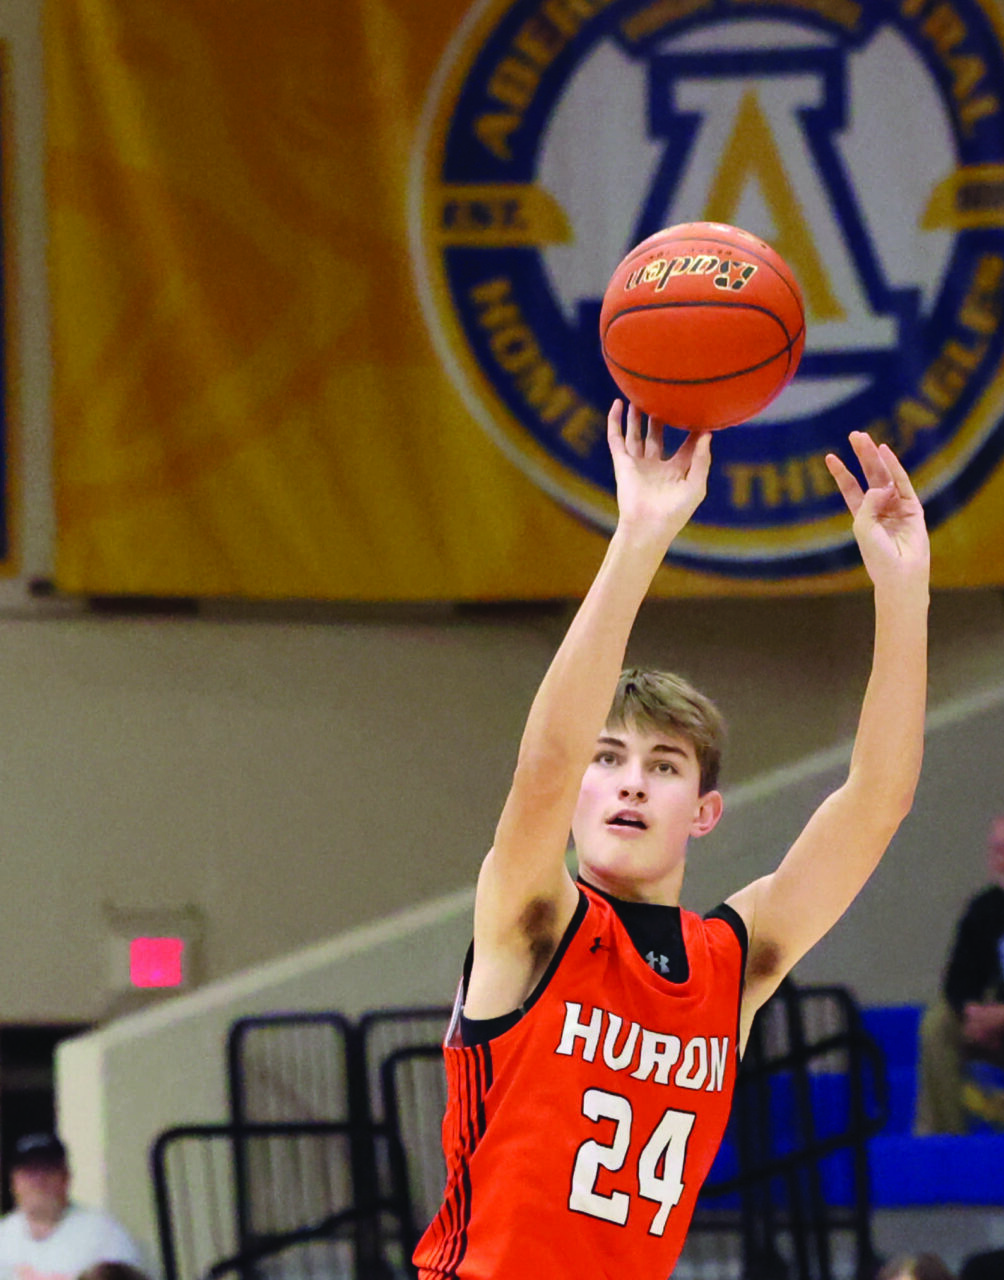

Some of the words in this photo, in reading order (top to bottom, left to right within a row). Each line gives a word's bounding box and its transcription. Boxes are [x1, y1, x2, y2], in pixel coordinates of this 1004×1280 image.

[624, 255, 758, 292] Baden
[555, 1000, 730, 1092] HURON
[567, 1086, 697, 1238] 24
